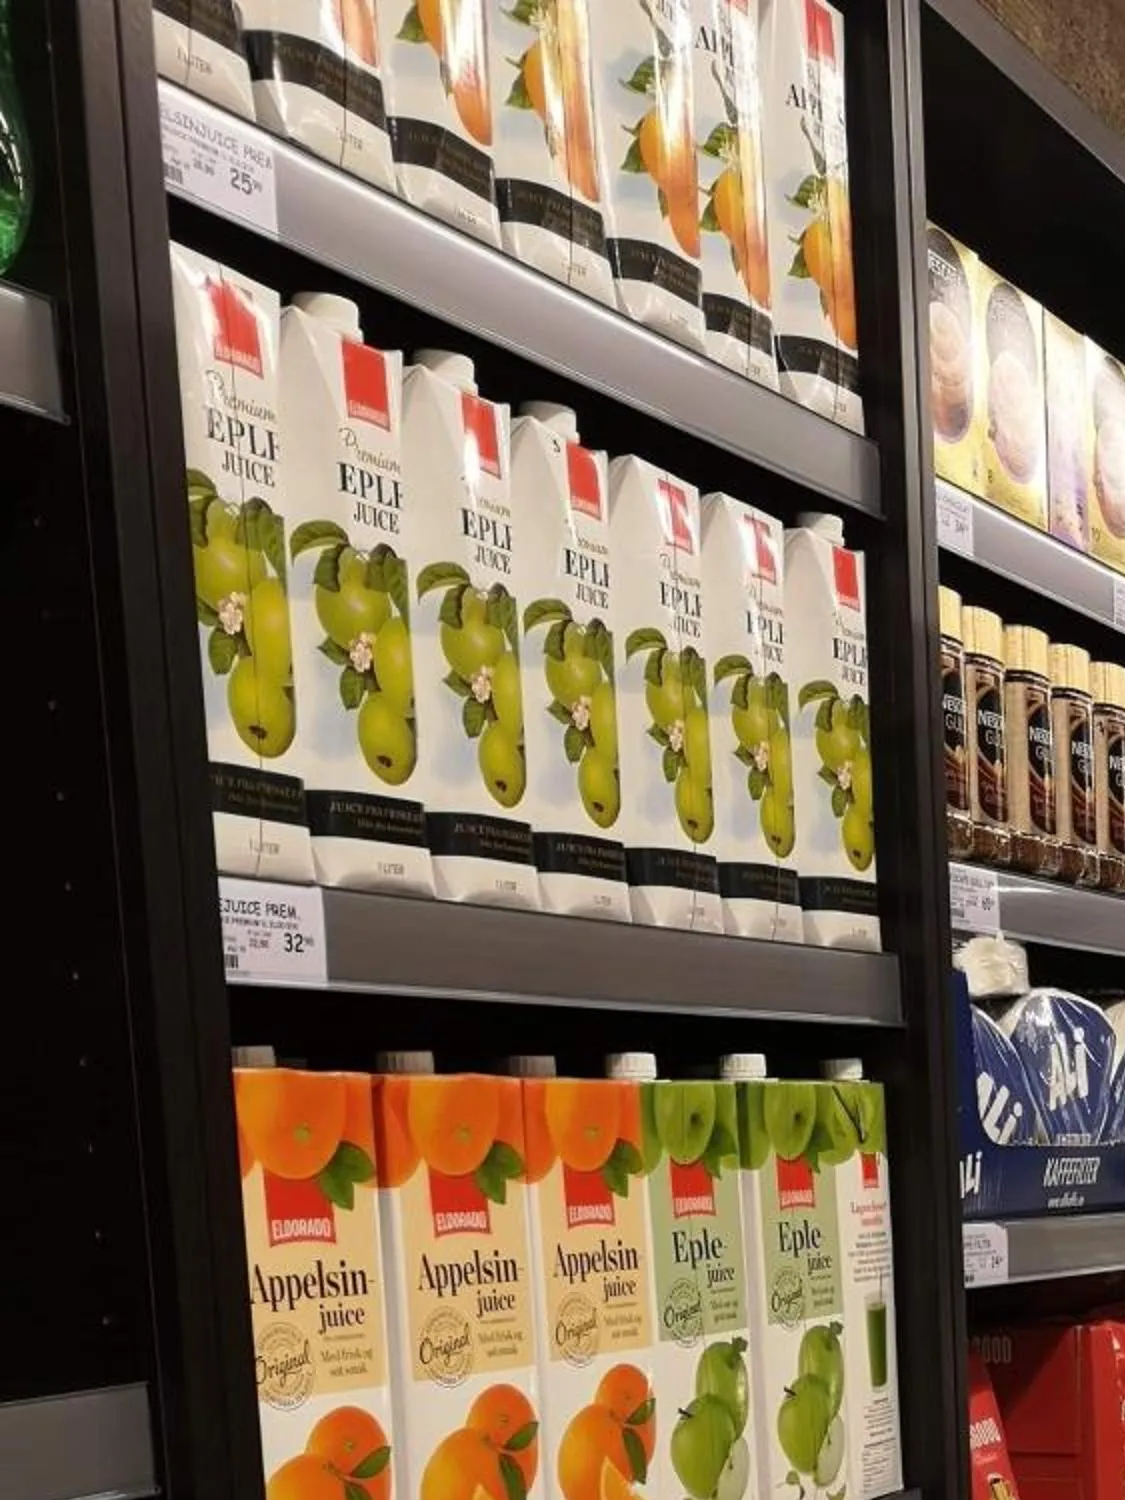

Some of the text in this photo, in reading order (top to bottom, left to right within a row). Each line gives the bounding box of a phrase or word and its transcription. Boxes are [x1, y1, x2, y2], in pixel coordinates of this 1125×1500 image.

[230, 167, 254, 196] 25
[221, 456, 276, 489] JUICE
[354, 501, 403, 536] JUICE
[475, 544, 512, 576] JUICE
[575, 584, 610, 611] JUICE
[284, 932, 305, 953] 32
[272, 1217, 333, 1243] ELDORADO
[435, 1209, 488, 1233] ELDORADO
[707, 1256, 738, 1289] juice
[808, 1249, 834, 1276] juice
[475, 1285, 518, 1319] juice
[603, 1271, 639, 1304] juice
[319, 1300, 367, 1336] juice
[419, 1322, 473, 1366] Original
